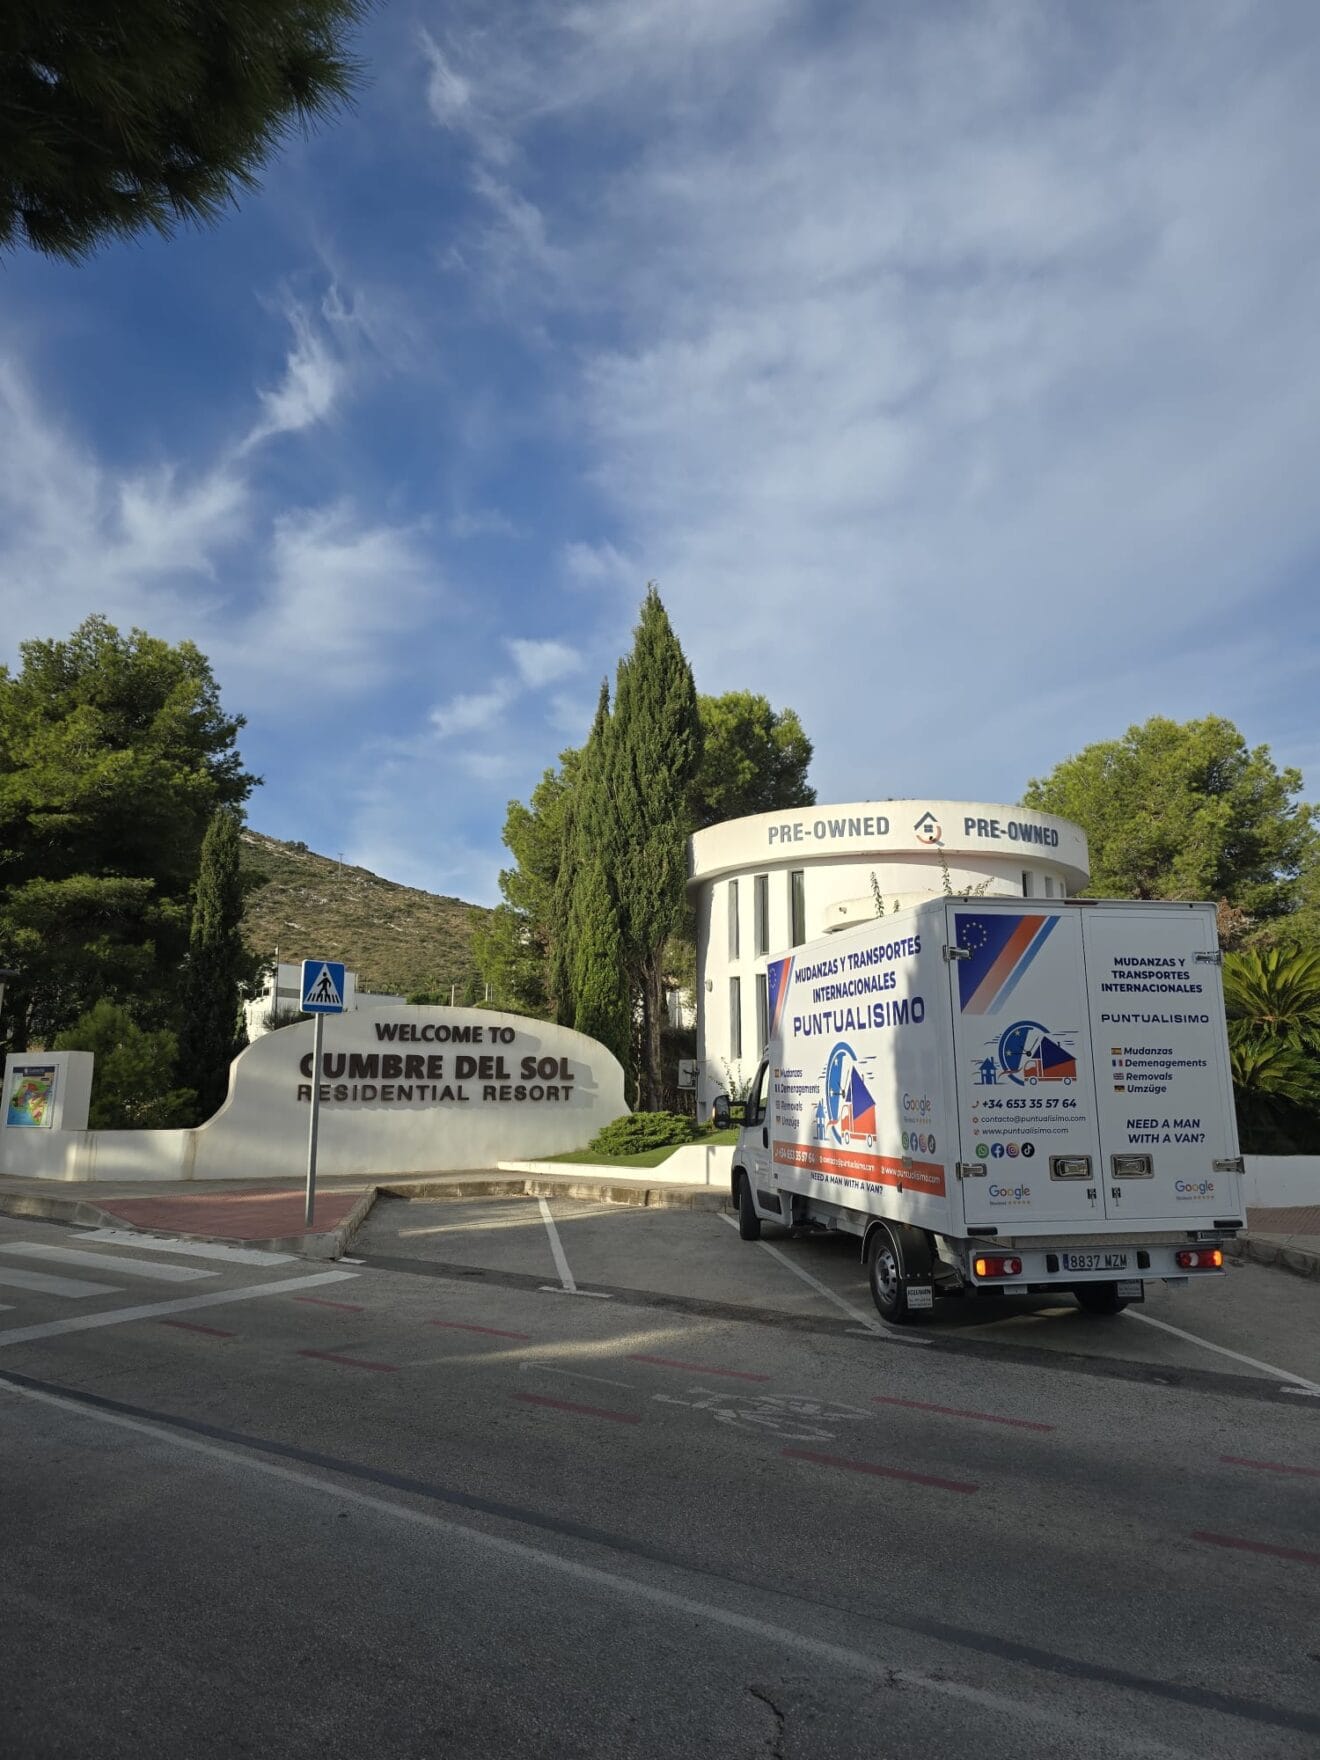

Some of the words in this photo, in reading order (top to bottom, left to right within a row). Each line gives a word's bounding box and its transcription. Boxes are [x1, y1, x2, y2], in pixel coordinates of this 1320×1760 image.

[768, 817, 890, 845] PRE-OWNED
[964, 817, 1059, 848] PRE-OWNED
[795, 960, 839, 984] MUDANZAS
[839, 956, 847, 973] Y
[847, 934, 922, 970] TRANSPORTES
[1114, 957, 1175, 967] MUDANZAS
[1175, 957, 1185, 967] Y
[1111, 970, 1190, 980] TRANSPORTES
[812, 970, 897, 1003] INTERNACIONALES
[1101, 982, 1203, 994] INTERNACIONALES
[793, 996, 925, 1038] PUNTUALISIMO
[1101, 1013, 1210, 1024] PUNTUALISIMO
[374, 1023, 484, 1044] WELCOME
[488, 1024, 516, 1043] TO
[1123, 1046, 1173, 1056] Mudanzas
[300, 1054, 443, 1080] CUMBRE
[455, 1056, 510, 1080] DEL
[520, 1056, 575, 1080] SOL
[1124, 1058, 1208, 1070] Demenagements
[1125, 1071, 1173, 1081] Removals
[297, 1084, 470, 1102] RESIDENTIAL
[483, 1084, 574, 1102] RESORT
[1126, 1083, 1167, 1095] Umzüge
[903, 1093, 931, 1116] Google
[982, 1099, 1003, 1109] +34
[1006, 1099, 1026, 1109] 653
[1029, 1099, 1043, 1108] 35
[1045, 1099, 1059, 1108] 57
[1062, 1098, 1077, 1108] 64
[981, 1115, 1086, 1124] contacto@puntualisimo.com
[1126, 1119, 1158, 1130] NEED
[1161, 1119, 1171, 1129] A
[1173, 1119, 1201, 1129] MAN
[982, 1127, 1069, 1136] www.puntualisimo.com
[1128, 1133, 1160, 1144] WITH
[1162, 1133, 1172, 1143] A
[1173, 1133, 1206, 1143] VAN?
[830, 1176, 843, 1186] MAN
[843, 1178, 859, 1189] WITH
[866, 1183, 883, 1194] VAN?
[1175, 1179, 1214, 1195] Google
[989, 1184, 1031, 1200] Google
[1070, 1255, 1101, 1268] 8837
